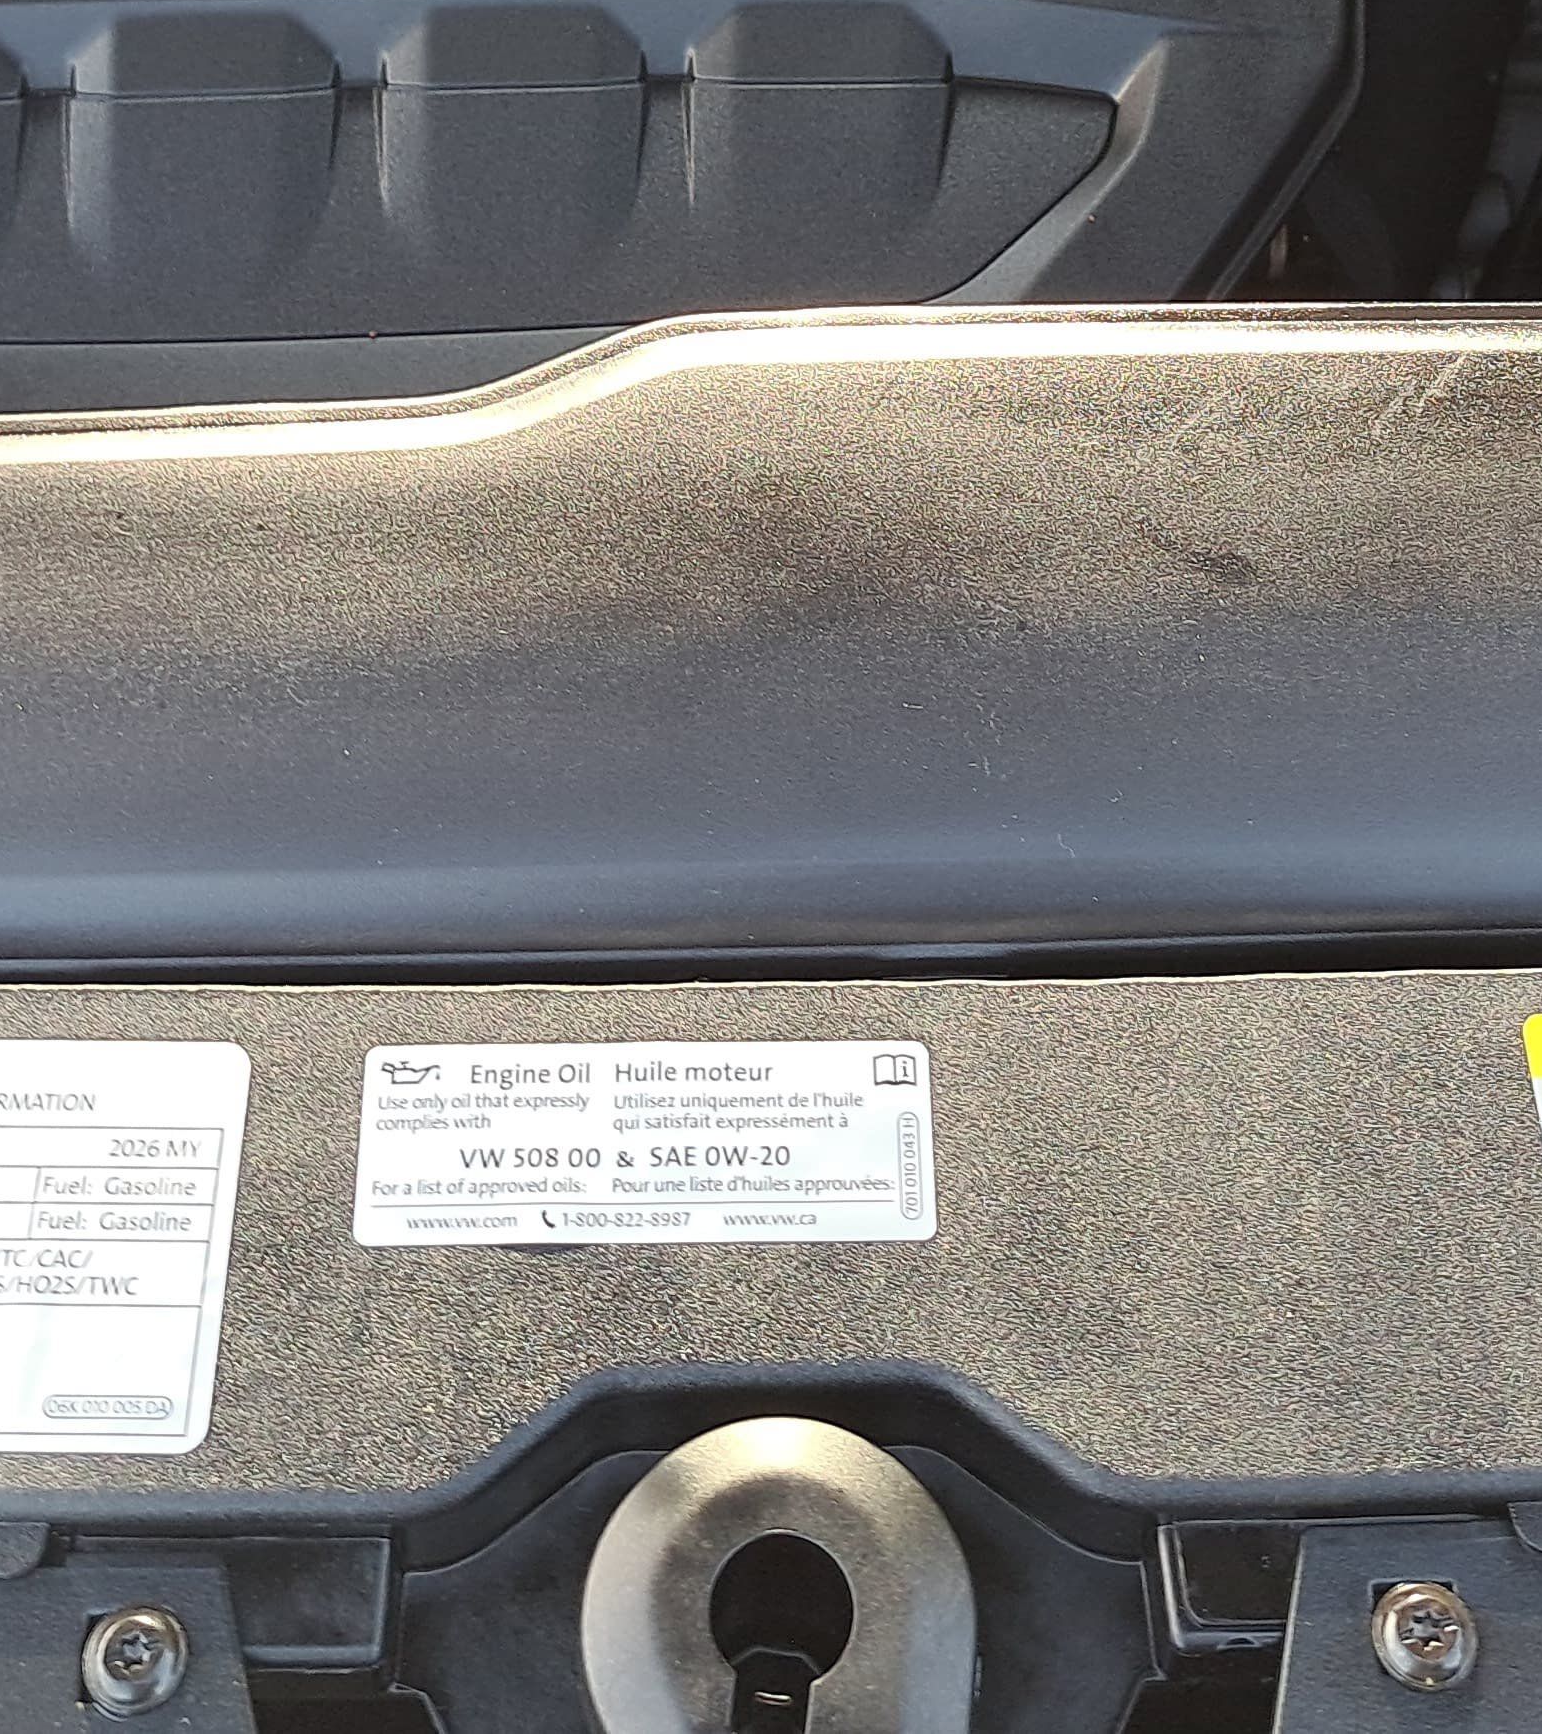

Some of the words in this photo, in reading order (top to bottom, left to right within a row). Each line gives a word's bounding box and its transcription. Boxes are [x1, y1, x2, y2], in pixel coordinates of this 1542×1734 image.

[470, 1063, 550, 1090] Engine
[557, 1062, 590, 1083] Oil
[615, 1060, 676, 1082] Huile
[684, 1062, 772, 1081] moteur
[377, 1095, 408, 1110] Use
[411, 1093, 447, 1114] only
[450, 1092, 471, 1108] oil
[474, 1093, 509, 1109] that
[512, 1092, 589, 1112] expressly
[613, 1092, 675, 1109] Utilisez
[679, 1092, 784, 1112] uniquement
[787, 1092, 809, 1107] de
[813, 1092, 863, 1107] l'huile
[375, 1114, 449, 1134] complies
[452, 1113, 491, 1129] with
[612, 1114, 640, 1134] qui
[643, 1112, 711, 1129] satisfait
[838, 1112, 848, 1128] à
[108, 1138, 160, 1157] 2026
[459, 1148, 504, 1168] VW
[513, 1147, 558, 1167] 508
[567, 1147, 600, 1168] 00
[616, 1150, 634, 1167] &
[650, 1145, 696, 1167] SAE
[705, 1145, 790, 1166] 0W-20
[42, 1175, 91, 1194] Fuel:
[103, 1176, 196, 1196] Gasoline
[371, 1180, 399, 1195] For
[401, 1183, 412, 1195] a
[416, 1179, 442, 1194] list
[445, 1177, 465, 1194] of
[467, 1176, 547, 1199] approved
[551, 1177, 586, 1193] oils:
[611, 1177, 650, 1193] Pour
[653, 1179, 686, 1192] une
[689, 1175, 723, 1192] liste
[726, 1175, 790, 1191] d'huiles
[793, 1174, 895, 1195] approuvées:
[37, 1210, 86, 1230] Fuel:
[98, 1210, 192, 1231] Gasoline
[562, 1211, 691, 1227] 1-800-822-8987
